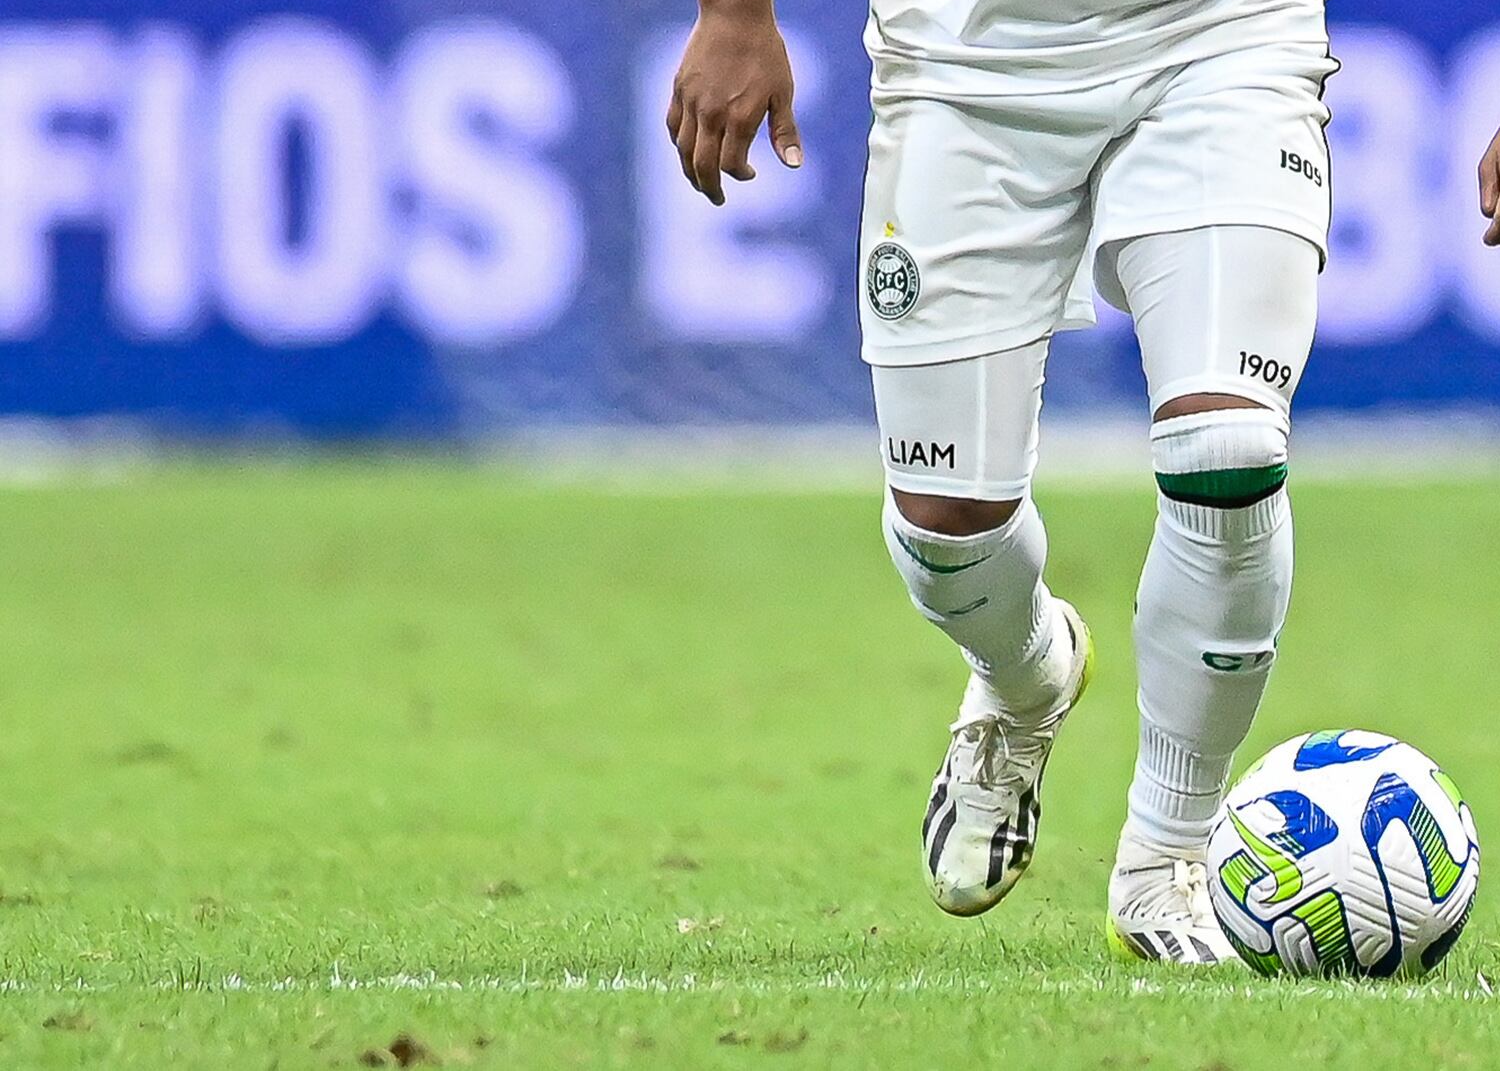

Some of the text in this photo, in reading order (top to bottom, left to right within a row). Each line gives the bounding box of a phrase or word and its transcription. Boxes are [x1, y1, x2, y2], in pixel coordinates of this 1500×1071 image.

[1279, 148, 1323, 188] 1909
[1238, 350, 1292, 390] 1909
[887, 436, 956, 470] LIAM
